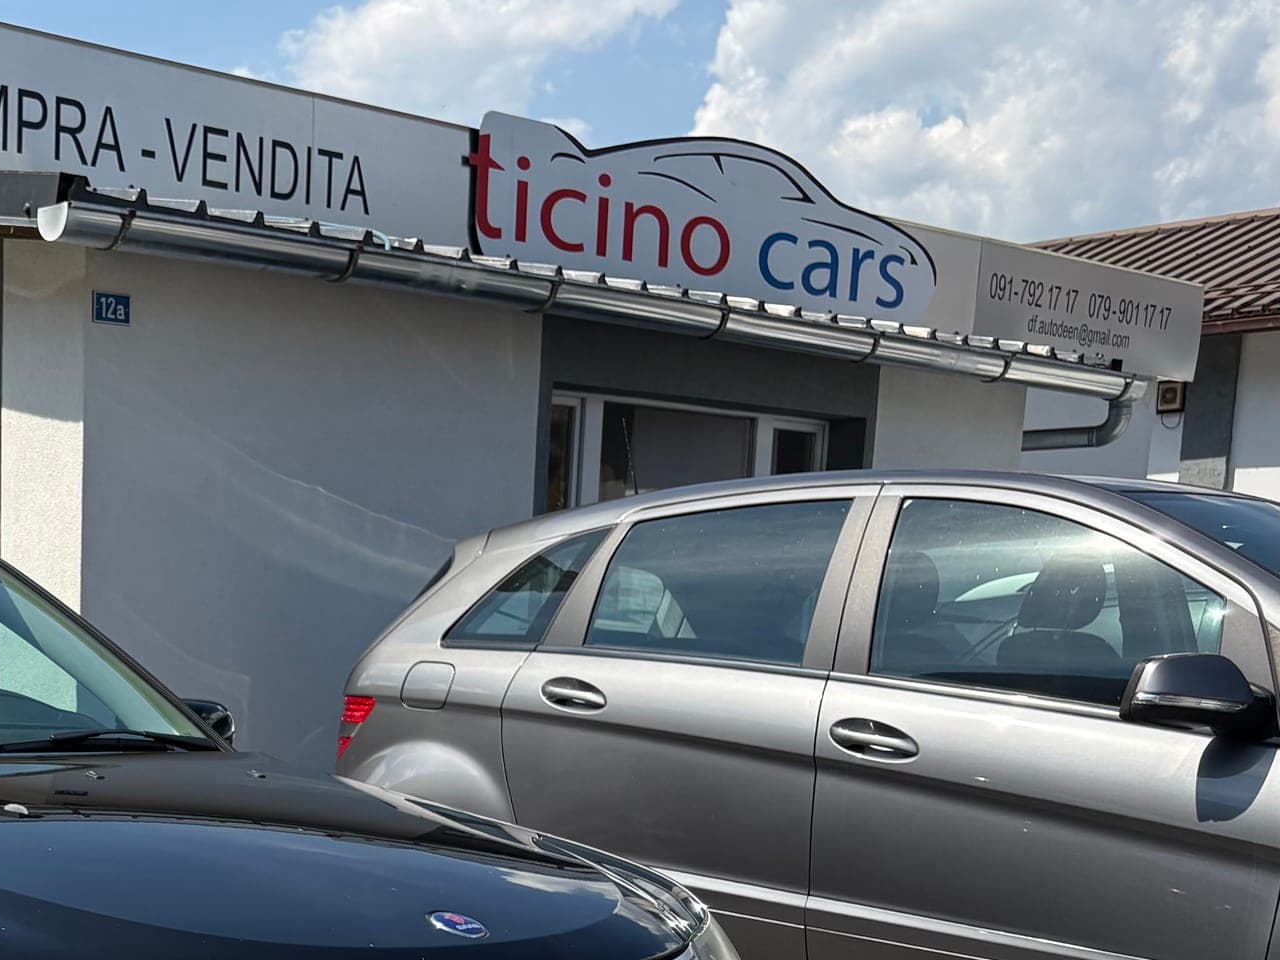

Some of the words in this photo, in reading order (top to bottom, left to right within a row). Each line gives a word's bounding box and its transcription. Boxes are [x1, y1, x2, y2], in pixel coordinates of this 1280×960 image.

[470, 133, 731, 276] ticino
[758, 232, 905, 309] cars
[100, 297, 126, 320] 12a
[1048, 284, 1062, 313] 17
[1065, 289, 1079, 315] 17
[1143, 303, 1157, 329] 17
[1159, 307, 1172, 331] 17
[1027, 315, 1130, 350] df.autodeen@gmail.com
